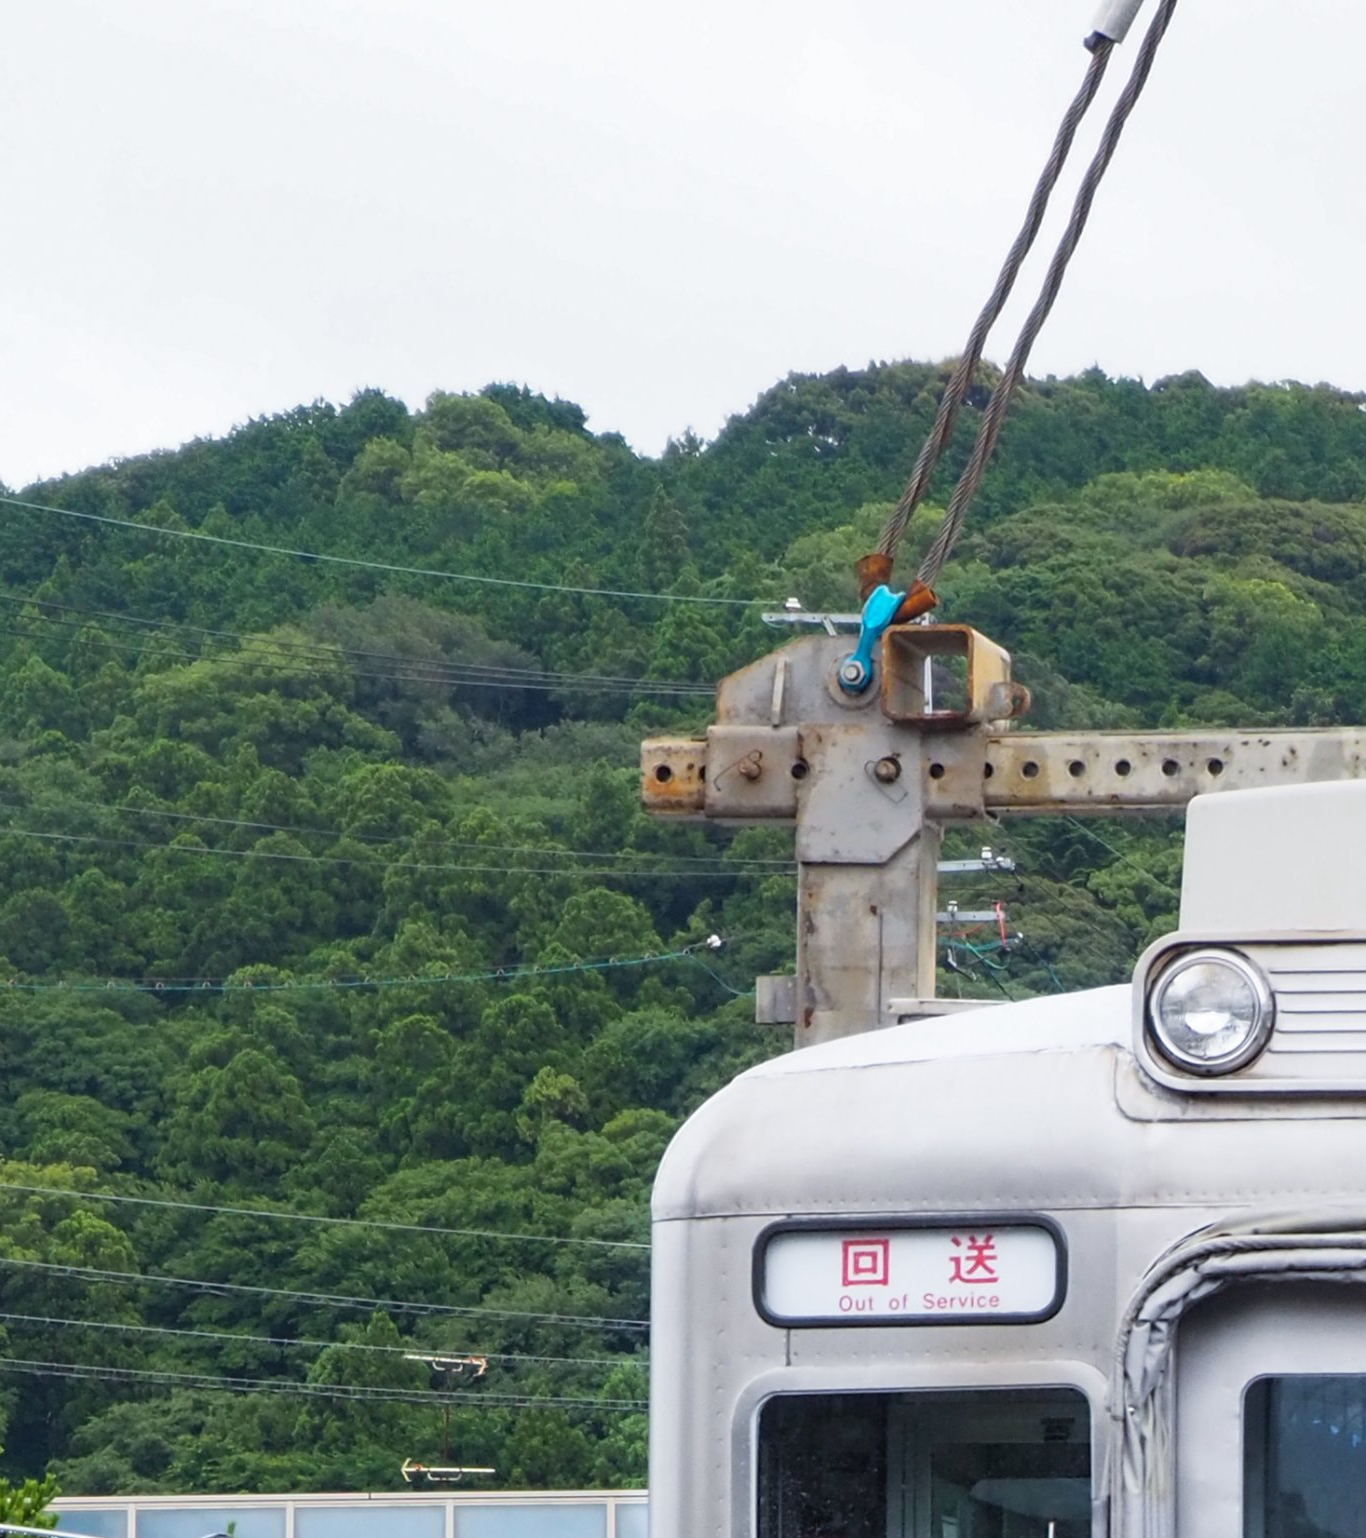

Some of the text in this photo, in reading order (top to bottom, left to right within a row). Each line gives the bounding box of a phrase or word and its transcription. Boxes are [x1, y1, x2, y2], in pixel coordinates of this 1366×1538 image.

[839, 1292, 1001, 1312] Out of Service
